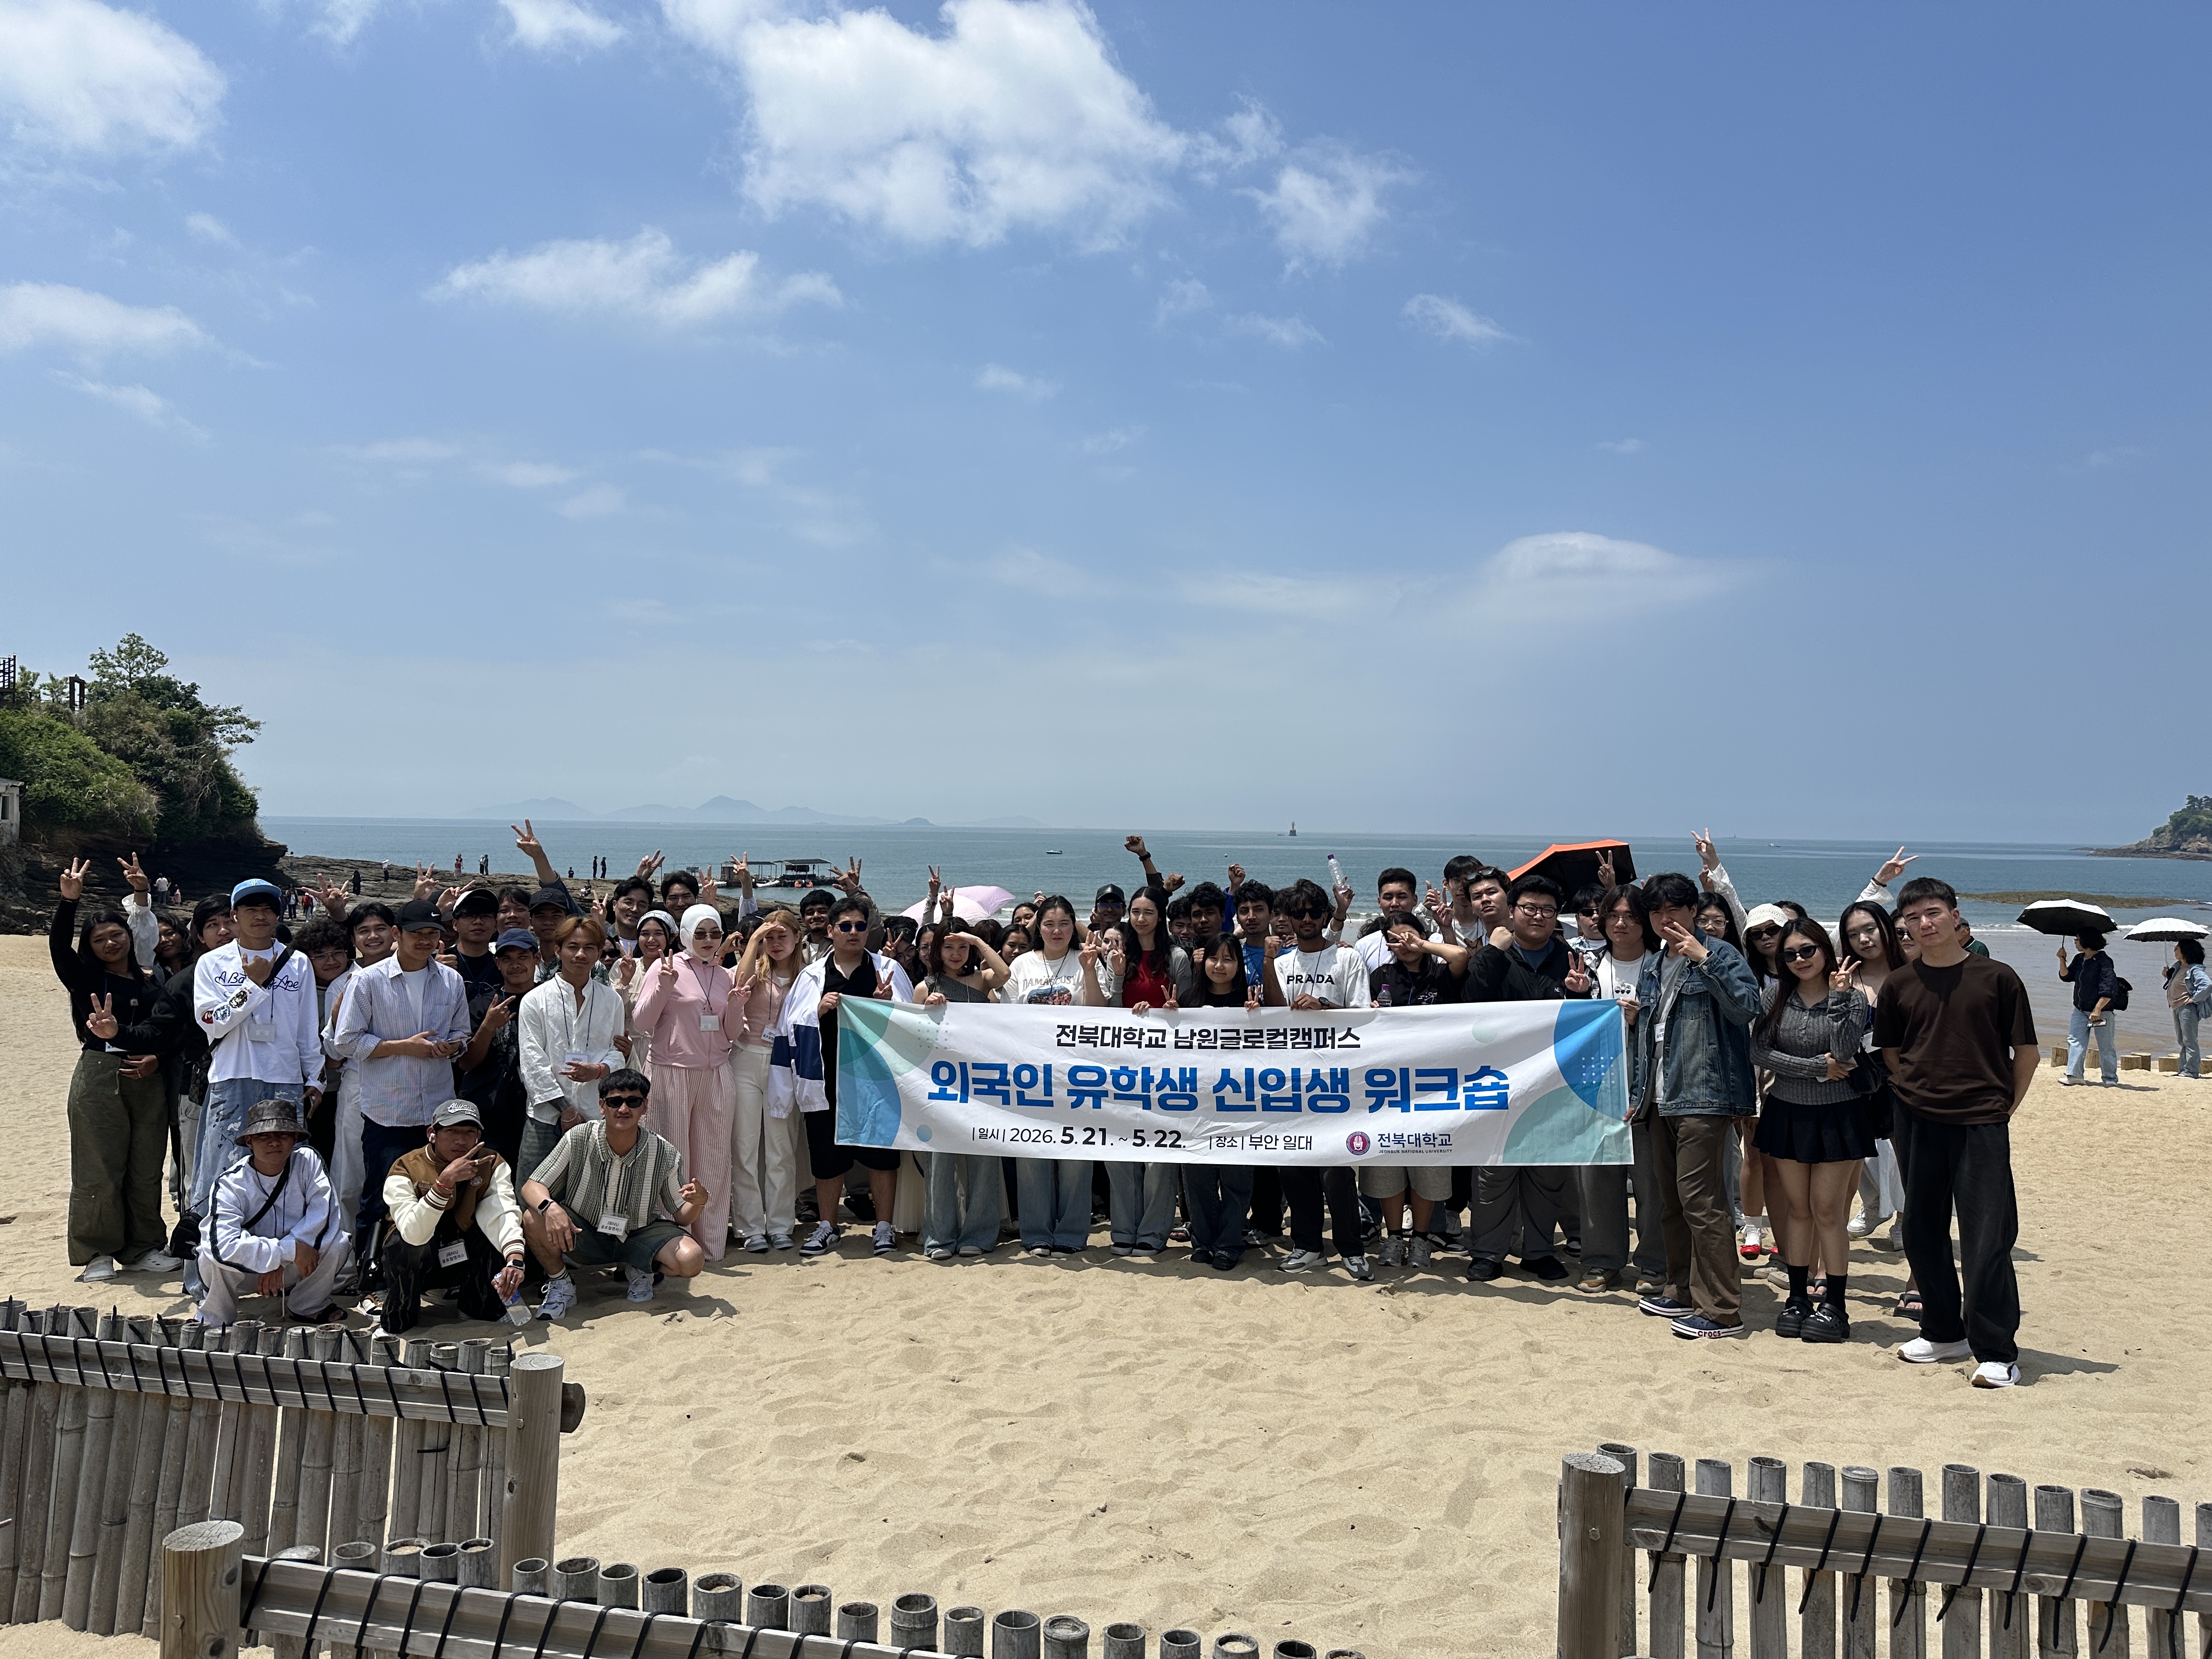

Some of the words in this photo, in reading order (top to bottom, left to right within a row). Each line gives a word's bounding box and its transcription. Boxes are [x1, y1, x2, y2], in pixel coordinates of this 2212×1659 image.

[275, 975, 299, 991] Ape
[1286, 974, 1335, 985] PRADA
[1056, 1025, 1166, 1049] 전북대학교
[1174, 1026, 1361, 1049] 남원글로컬캠퍼스
[928, 1060, 1054, 1108] 외국인
[1067, 1065, 1199, 1111] 유학생
[1212, 1067, 1351, 1114] 신입생
[1364, 1065, 1510, 1114] 워크숍
[978, 1128, 999, 1140] 일시
[1009, 1128, 1056, 1143] 2026.
[1216, 1136, 1238, 1148] 장소
[1249, 1135, 1279, 1150] 부안
[1283, 1135, 1312, 1150] 일대
[1378, 1132, 1453, 1148] 전북대학교
